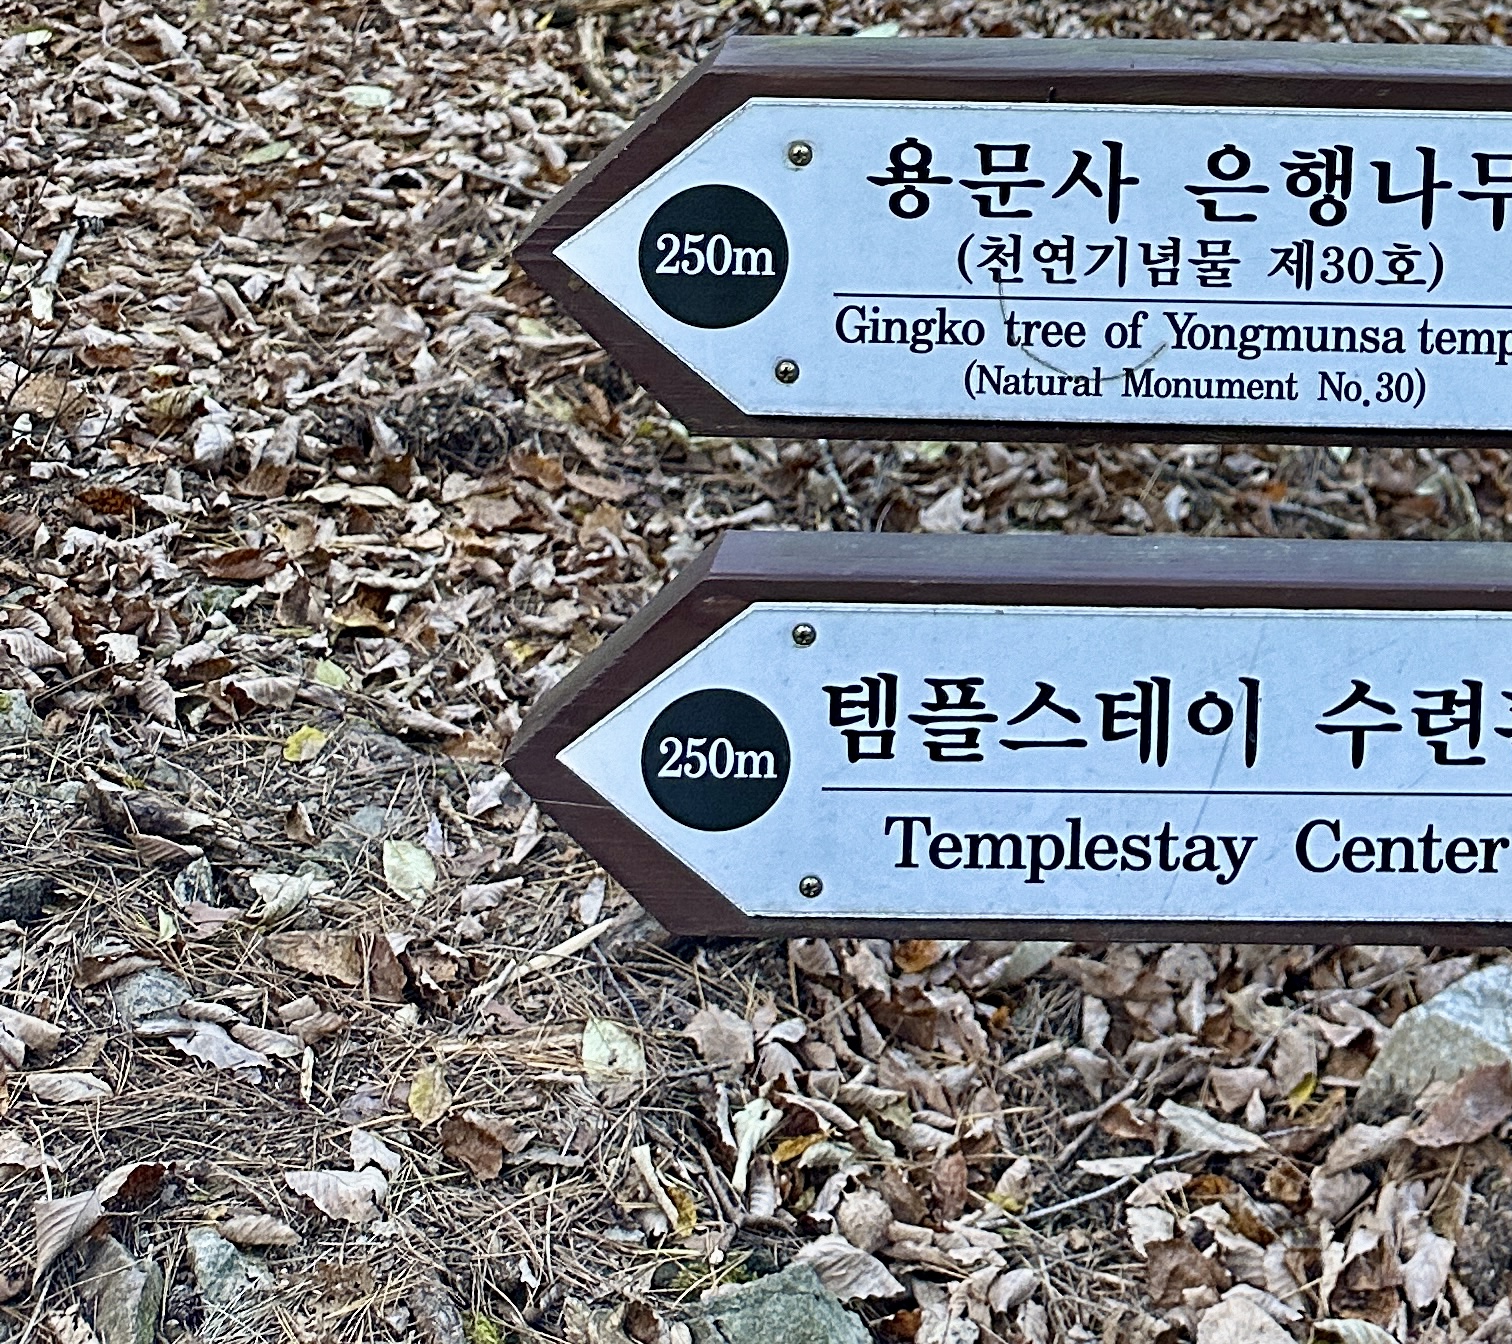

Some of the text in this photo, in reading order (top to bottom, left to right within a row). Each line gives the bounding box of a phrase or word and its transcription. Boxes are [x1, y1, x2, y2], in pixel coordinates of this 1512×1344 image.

[867, 138, 1139, 224] 용문사
[656, 234, 776, 277] 250m
[957, 233, 1444, 292] (천연기념물 제30호)
[835, 305, 985, 354] Gingko
[1004, 312, 1086, 350] tree
[1105, 311, 1148, 349] of
[1163, 312, 1406, 361] Yongmunsa
[964, 359, 1102, 401] (Natural
[1121, 367, 1298, 402] Monument
[822, 673, 1260, 769] 템플스테이
[658, 737, 778, 780] 250m
[885, 816, 1509, 885] Templestay Center
